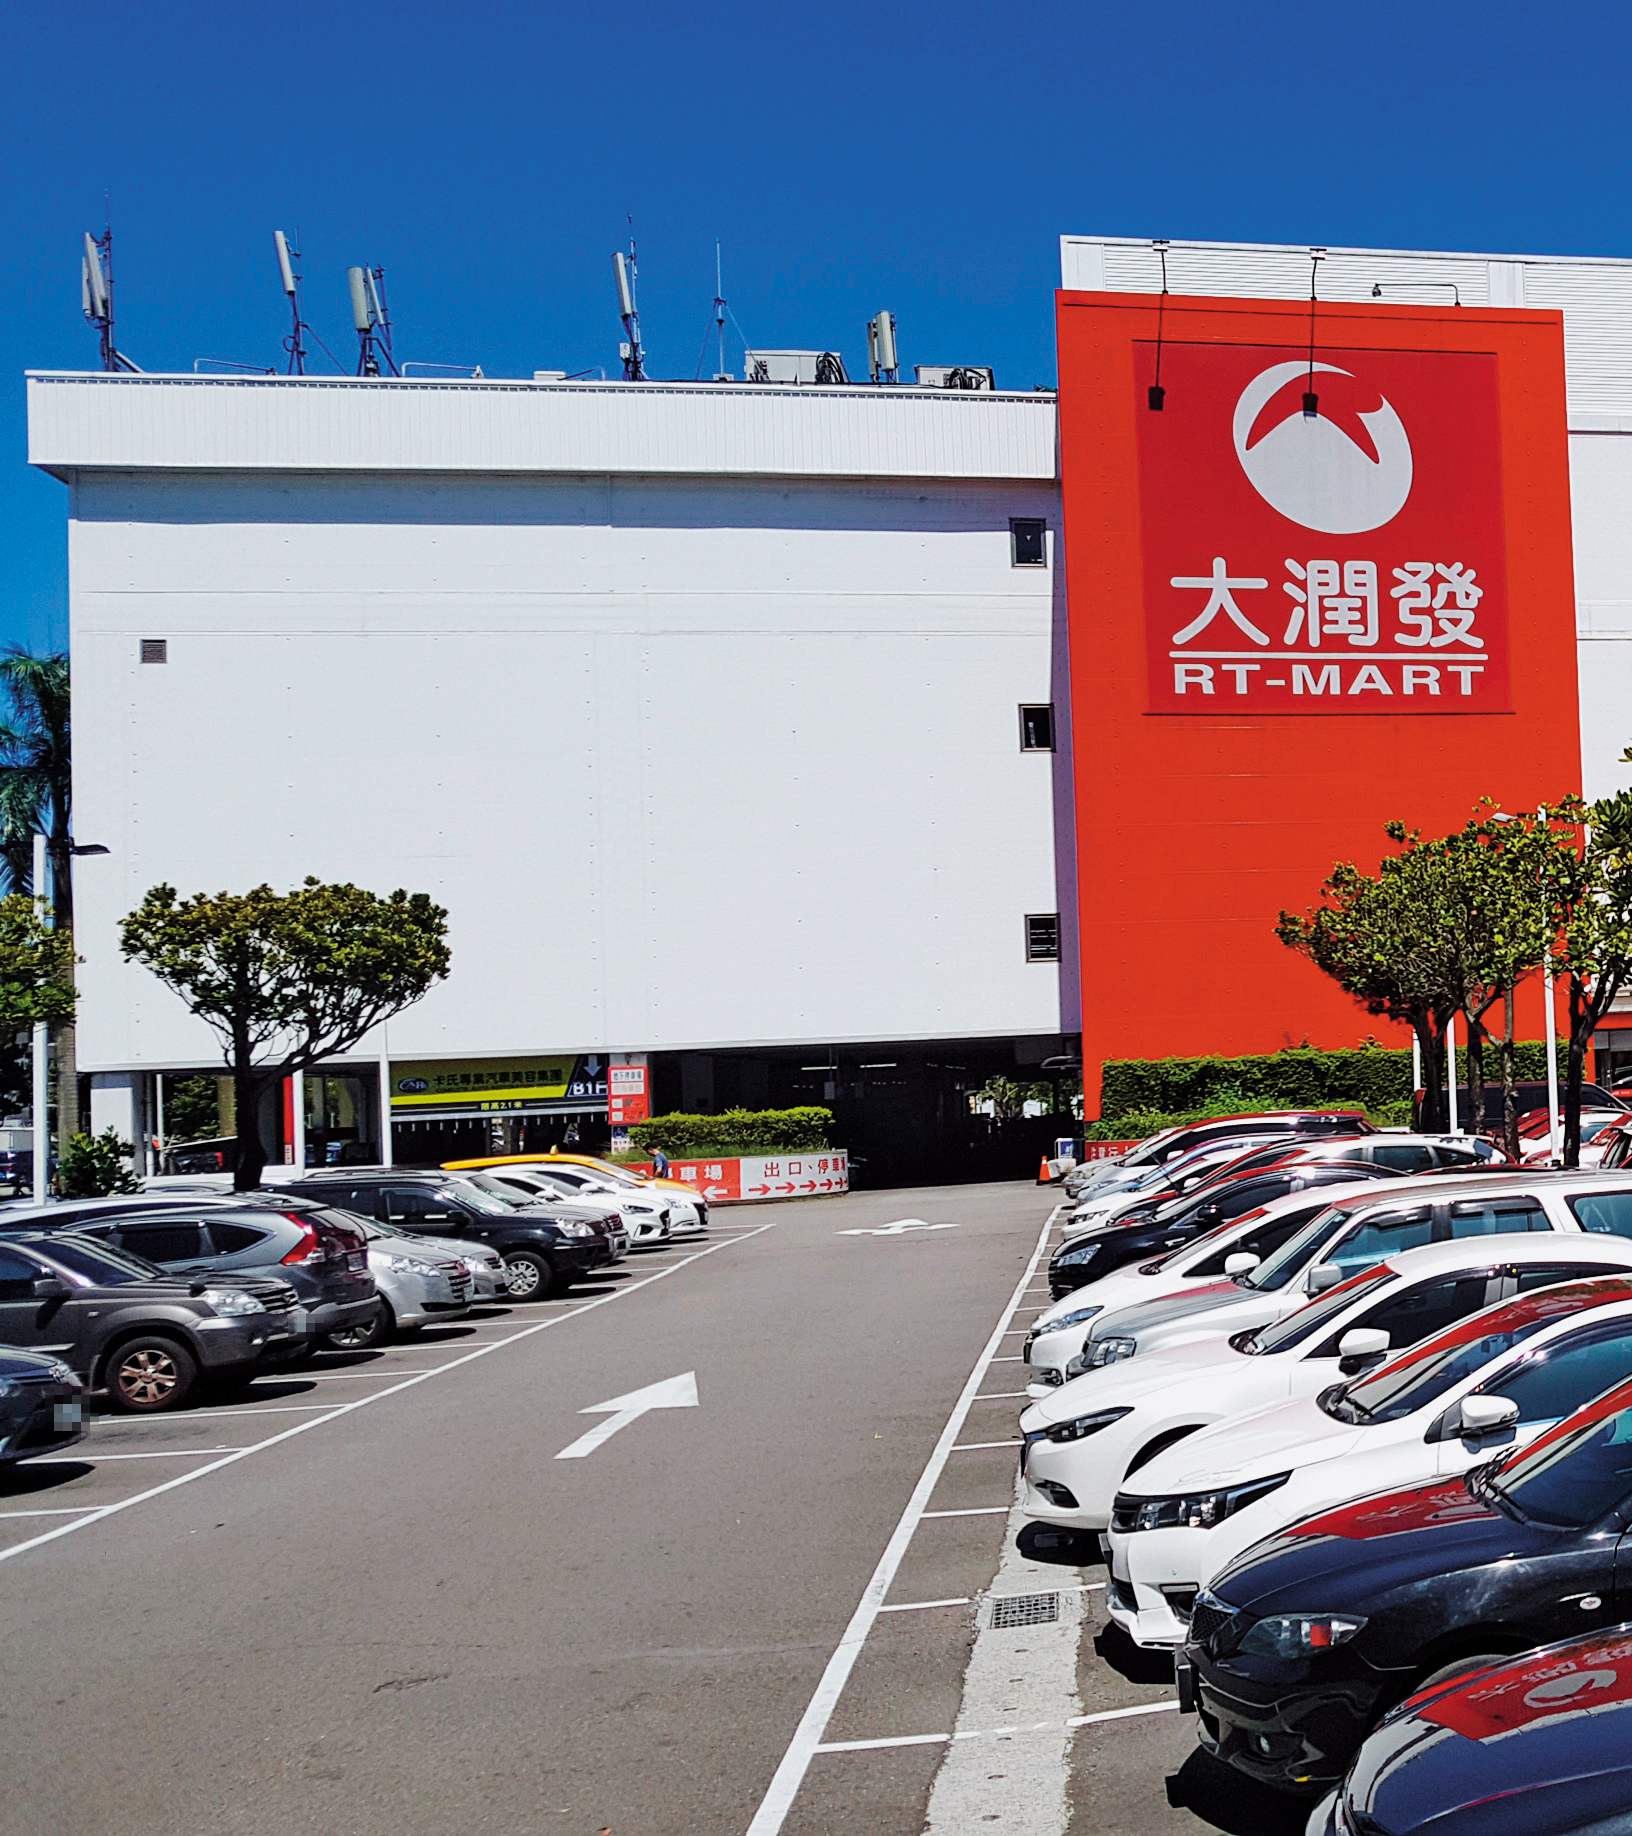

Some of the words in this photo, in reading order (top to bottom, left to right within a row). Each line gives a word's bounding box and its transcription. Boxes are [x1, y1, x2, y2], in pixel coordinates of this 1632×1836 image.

[1169, 556, 1485, 649] 大潤發
[1173, 663, 1486, 697] RT-MART
